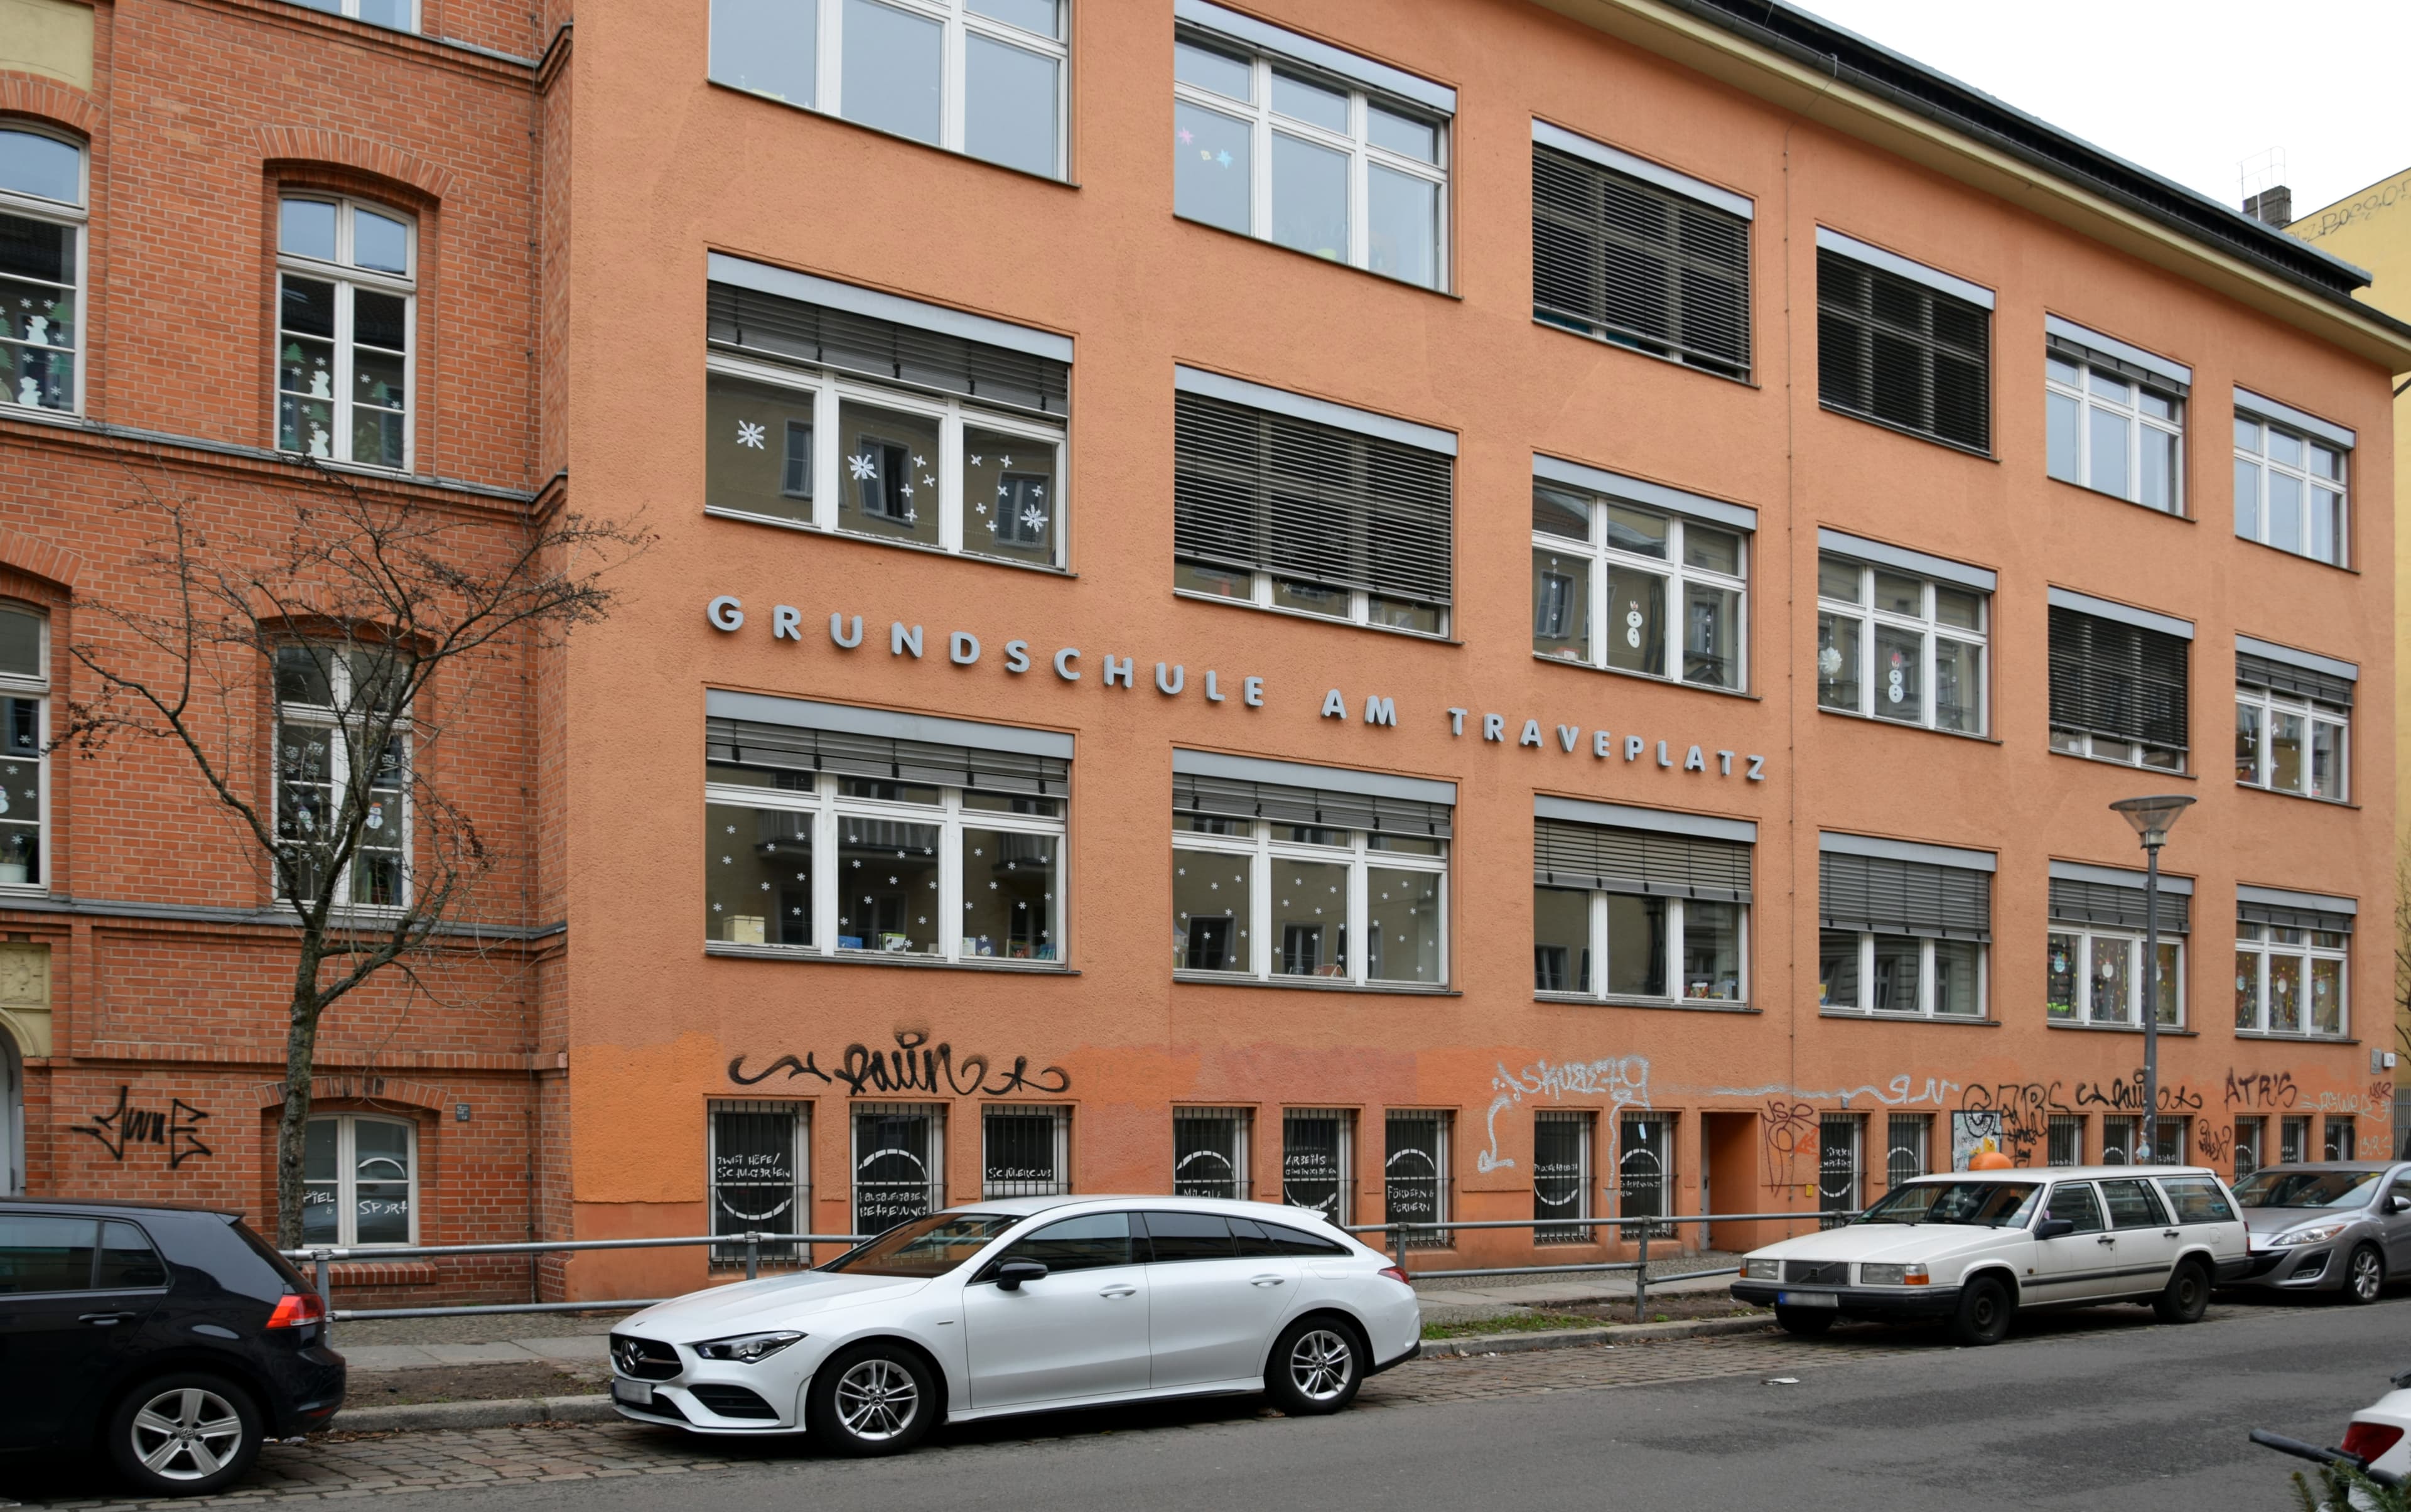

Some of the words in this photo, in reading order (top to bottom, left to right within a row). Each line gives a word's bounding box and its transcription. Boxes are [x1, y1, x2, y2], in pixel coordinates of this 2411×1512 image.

[707, 595, 1264, 707] GRUNDSCHULE
[1320, 688, 1397, 726] AM
[1447, 707, 1766, 780] TRAVEPLATZ
